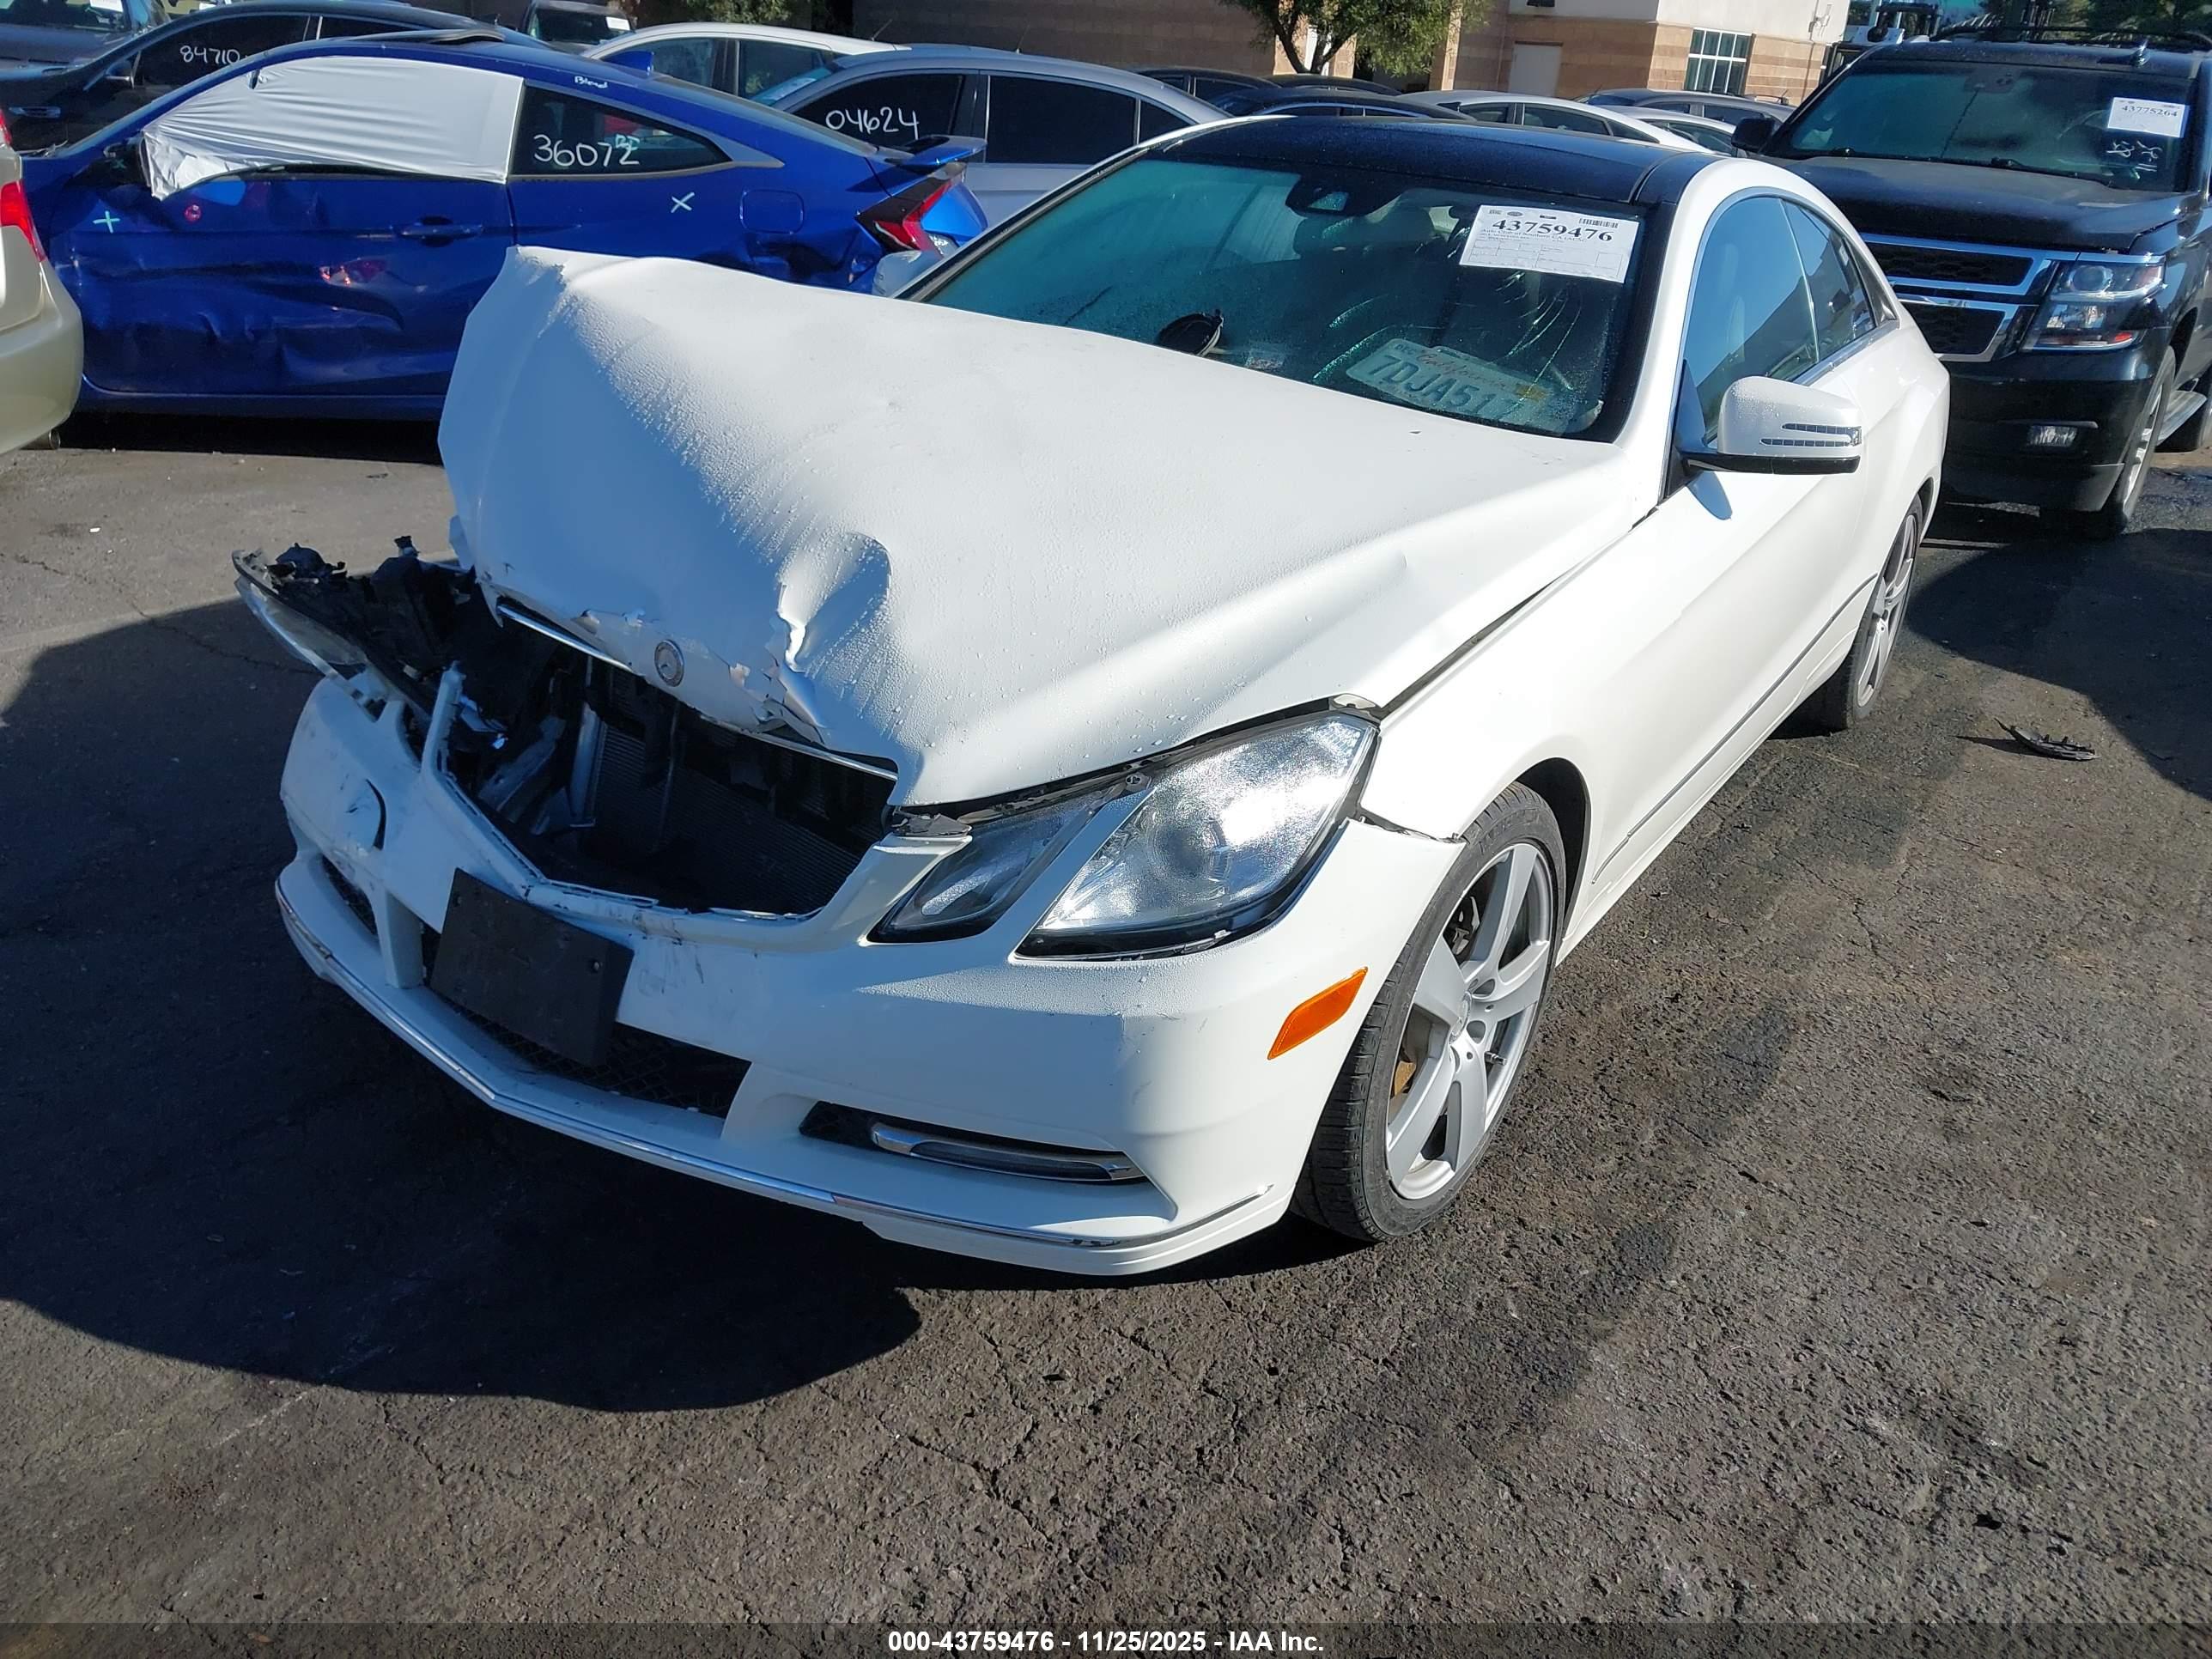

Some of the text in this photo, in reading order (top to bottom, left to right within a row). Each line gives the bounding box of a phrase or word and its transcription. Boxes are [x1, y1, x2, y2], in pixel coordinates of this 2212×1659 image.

[179, 45, 240, 64] 84710
[825, 106, 920, 140] 04624
[2122, 105, 2179, 118] 43775264
[533, 134, 640, 167] 36072
[1492, 218, 1613, 242] 43759476
